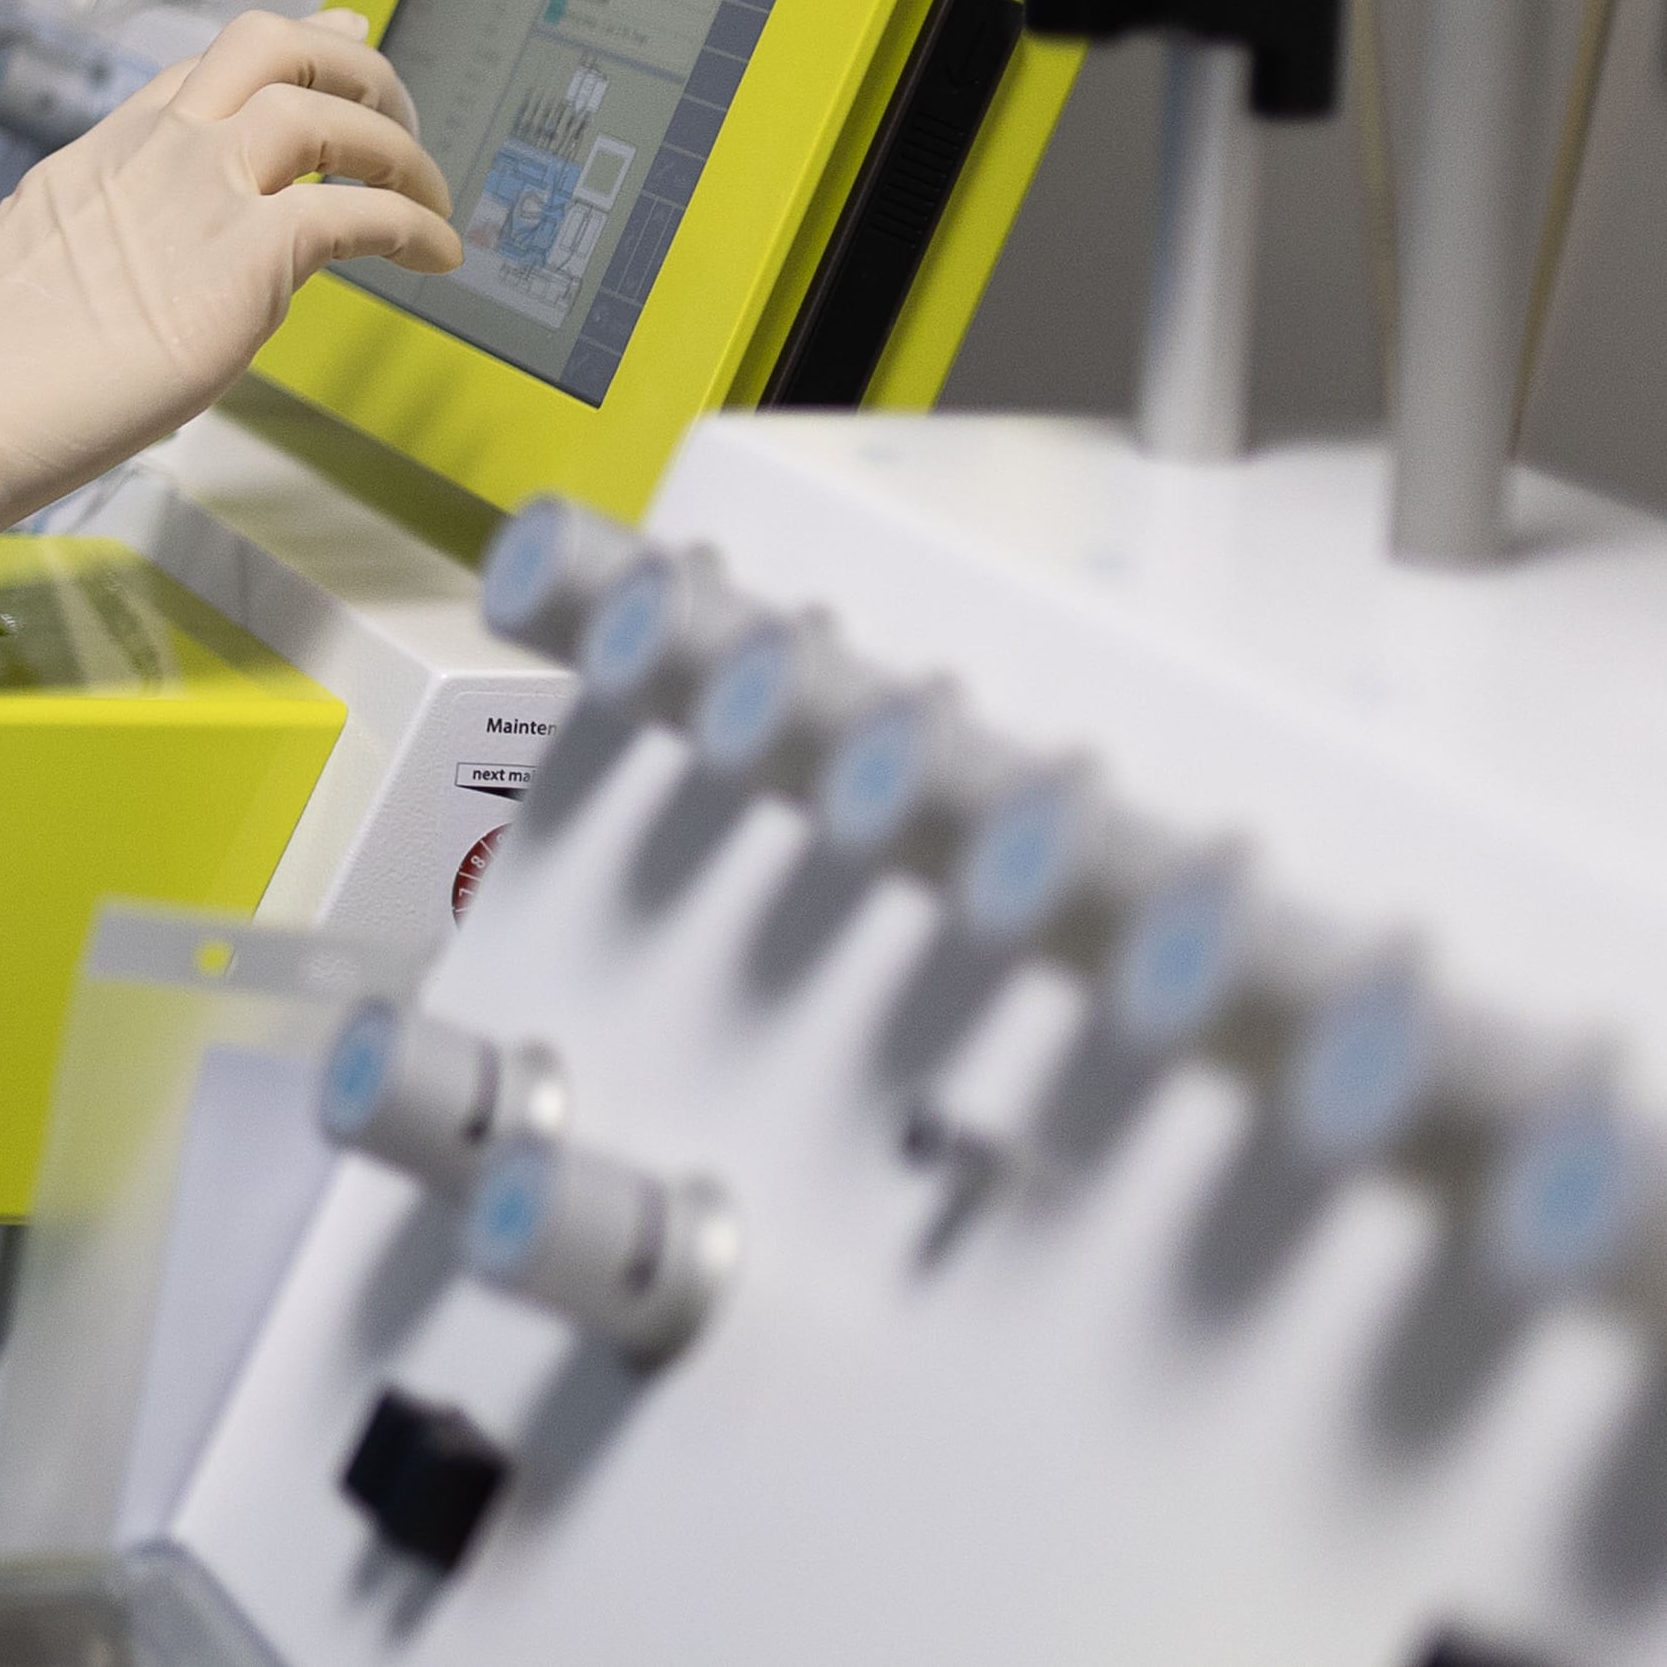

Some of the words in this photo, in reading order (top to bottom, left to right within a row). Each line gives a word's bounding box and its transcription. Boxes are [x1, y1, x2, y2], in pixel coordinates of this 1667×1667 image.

[486, 718, 557, 735] Mainten
[472, 769, 505, 781] next
[508, 770, 536, 782] ma
[470, 855, 485, 869] 8
